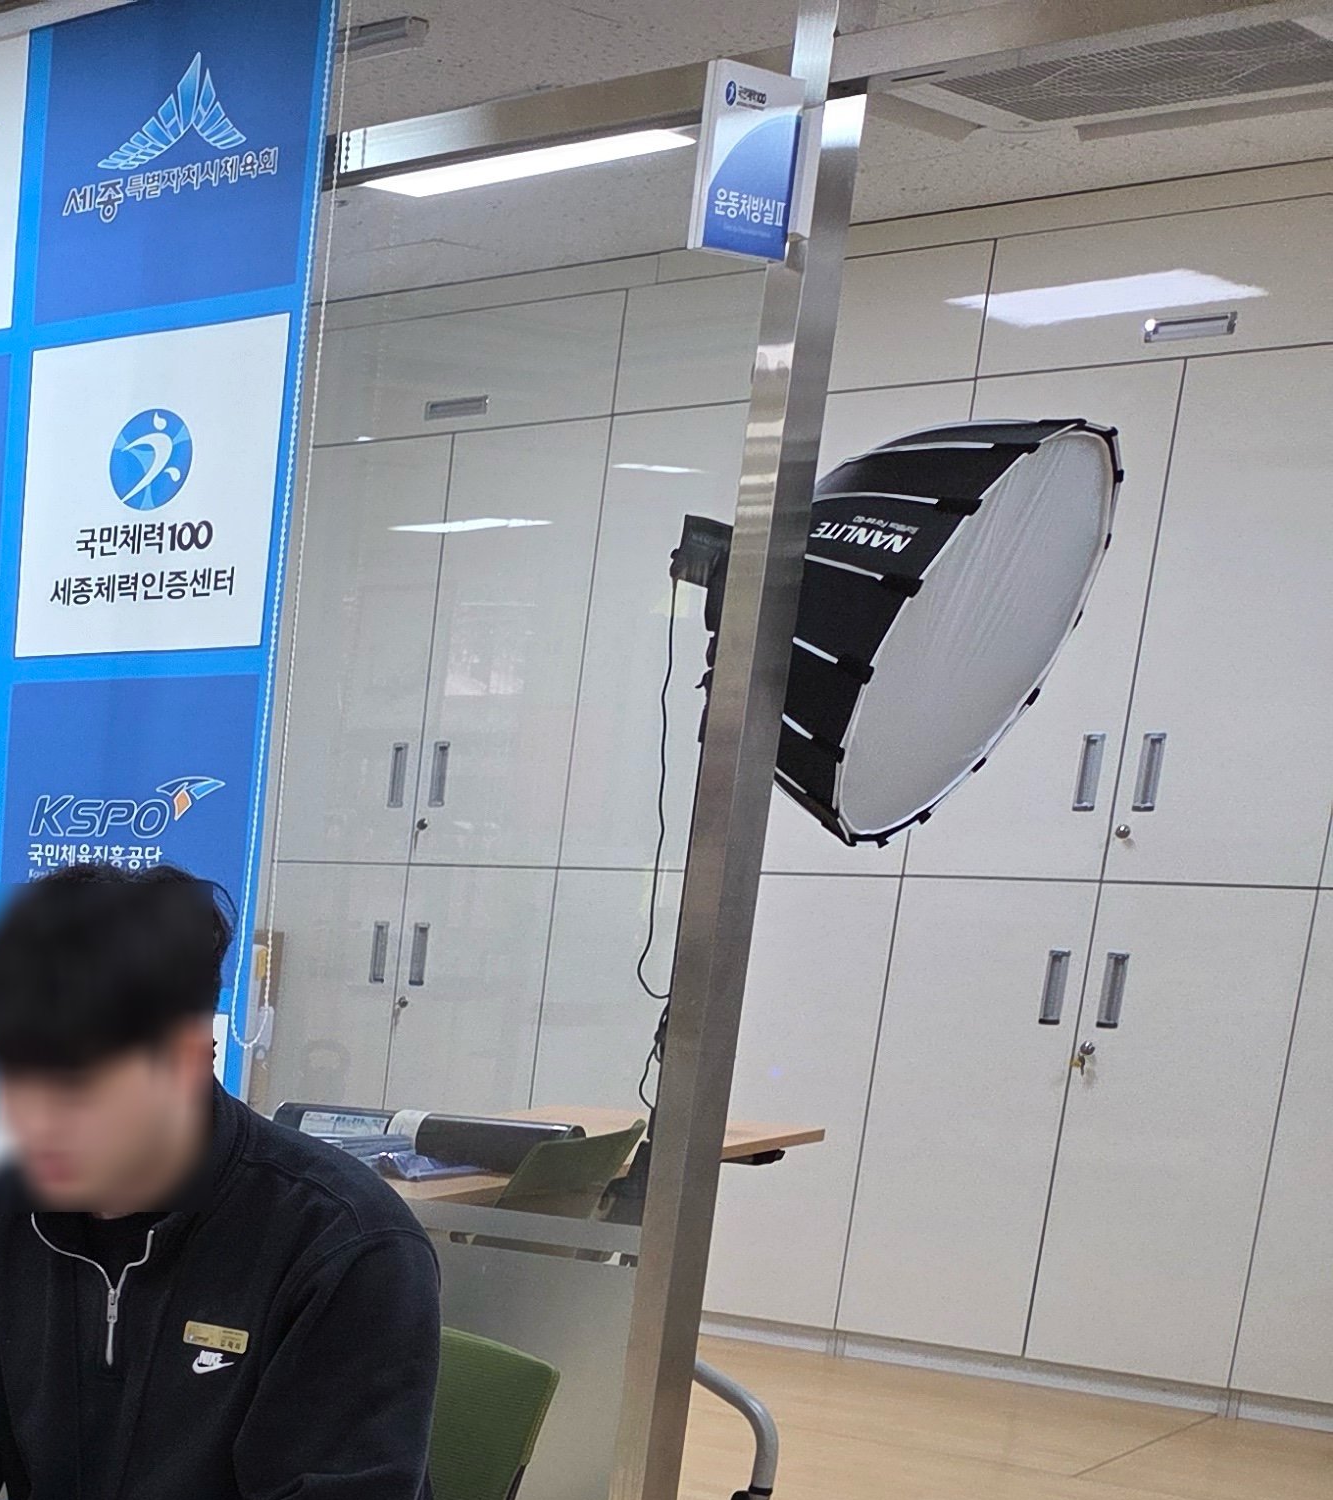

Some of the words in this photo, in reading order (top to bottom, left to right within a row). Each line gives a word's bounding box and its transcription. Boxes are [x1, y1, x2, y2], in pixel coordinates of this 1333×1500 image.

[75, 519, 213, 559] 국민체력100
[810, 522, 912, 553] NANLITE
[49, 566, 235, 607] 세종체력인증센터
[28, 793, 171, 839] KSPO
[27, 843, 163, 869] 국민체육진흥공단
